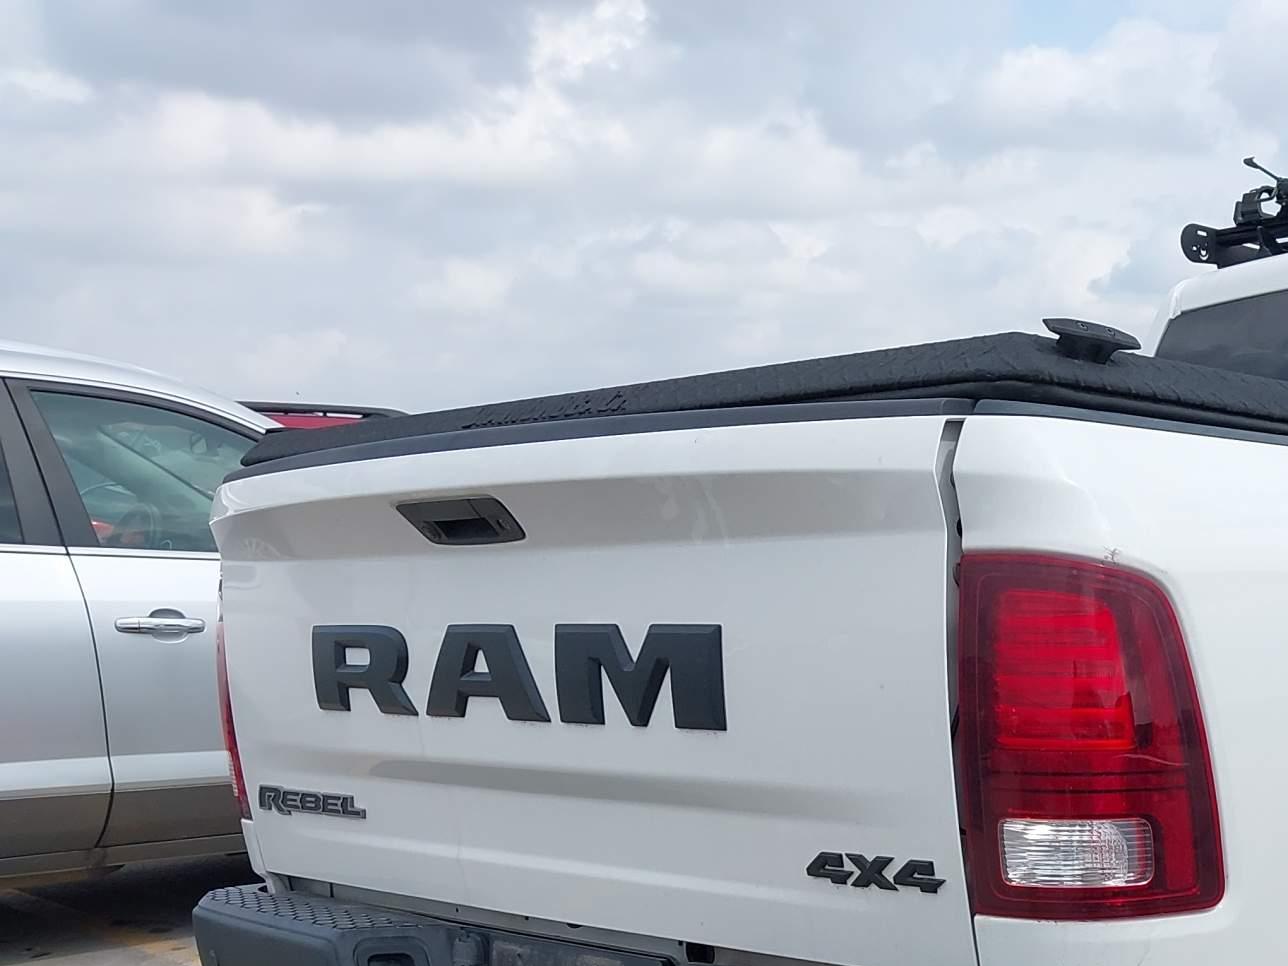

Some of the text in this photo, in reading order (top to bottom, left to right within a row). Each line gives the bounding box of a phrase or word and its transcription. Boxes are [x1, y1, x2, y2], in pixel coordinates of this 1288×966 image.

[311, 623, 728, 732] RAM
[259, 784, 367, 819] REBEL
[806, 851, 947, 894] 4X4
